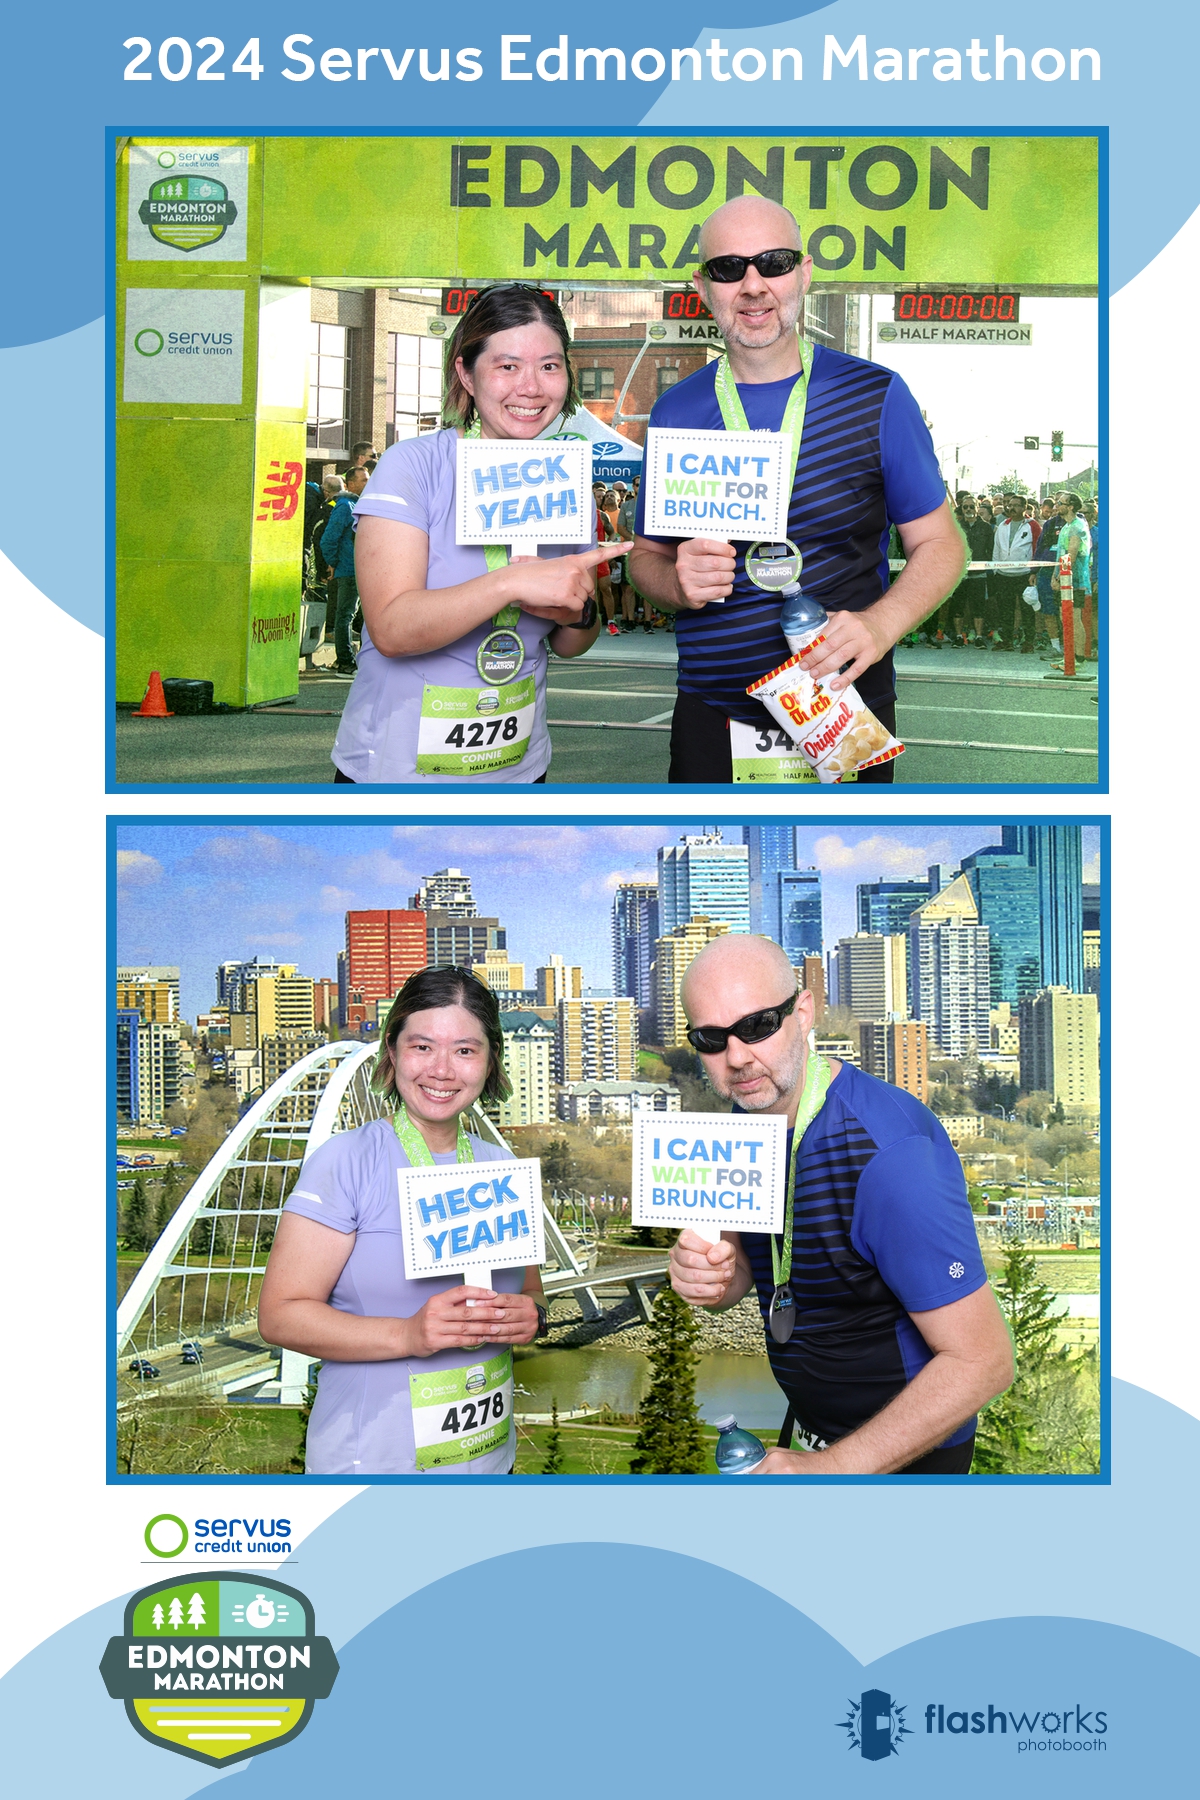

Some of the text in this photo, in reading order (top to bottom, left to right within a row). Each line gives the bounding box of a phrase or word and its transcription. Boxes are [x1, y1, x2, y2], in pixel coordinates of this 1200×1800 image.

[178, 152, 220, 161] servus
[450, 144, 991, 212] EDMONTON
[149, 202, 227, 214] EDMONTON
[160, 214, 216, 222] MARATHON
[523, 222, 907, 272] MARAON
[168, 332, 234, 345] servus
[900, 328, 1031, 341] HALF MARATHON
[168, 345, 233, 355] credit union
[471, 454, 570, 497] HECK
[593, 466, 631, 477] union
[666, 453, 770, 478] I CAN'T
[664, 478, 768, 500] WAIT FOR
[475, 489, 578, 532] YEAH!
[664, 499, 766, 522] BRUNCH.
[258, 613, 290, 635] Running
[445, 716, 518, 748] 4278
[755, 727, 799, 752] 34
[804, 701, 854, 759] Original
[461, 750, 502, 763] CONNIE
[469, 753, 521, 772] HALF MARATHON
[653, 1138, 763, 1163] I CAN'T
[652, 1166, 762, 1187] WAIT FOR
[415, 1174, 519, 1227] HECK
[652, 1188, 761, 1211] BRUNCH.
[423, 1209, 530, 1263] YEAH!
[433, 1384, 458, 1392] servus
[441, 1392, 504, 1434] 4278
[460, 1428, 495, 1448] CONNIE
[469, 1446, 484, 1456] HALF
